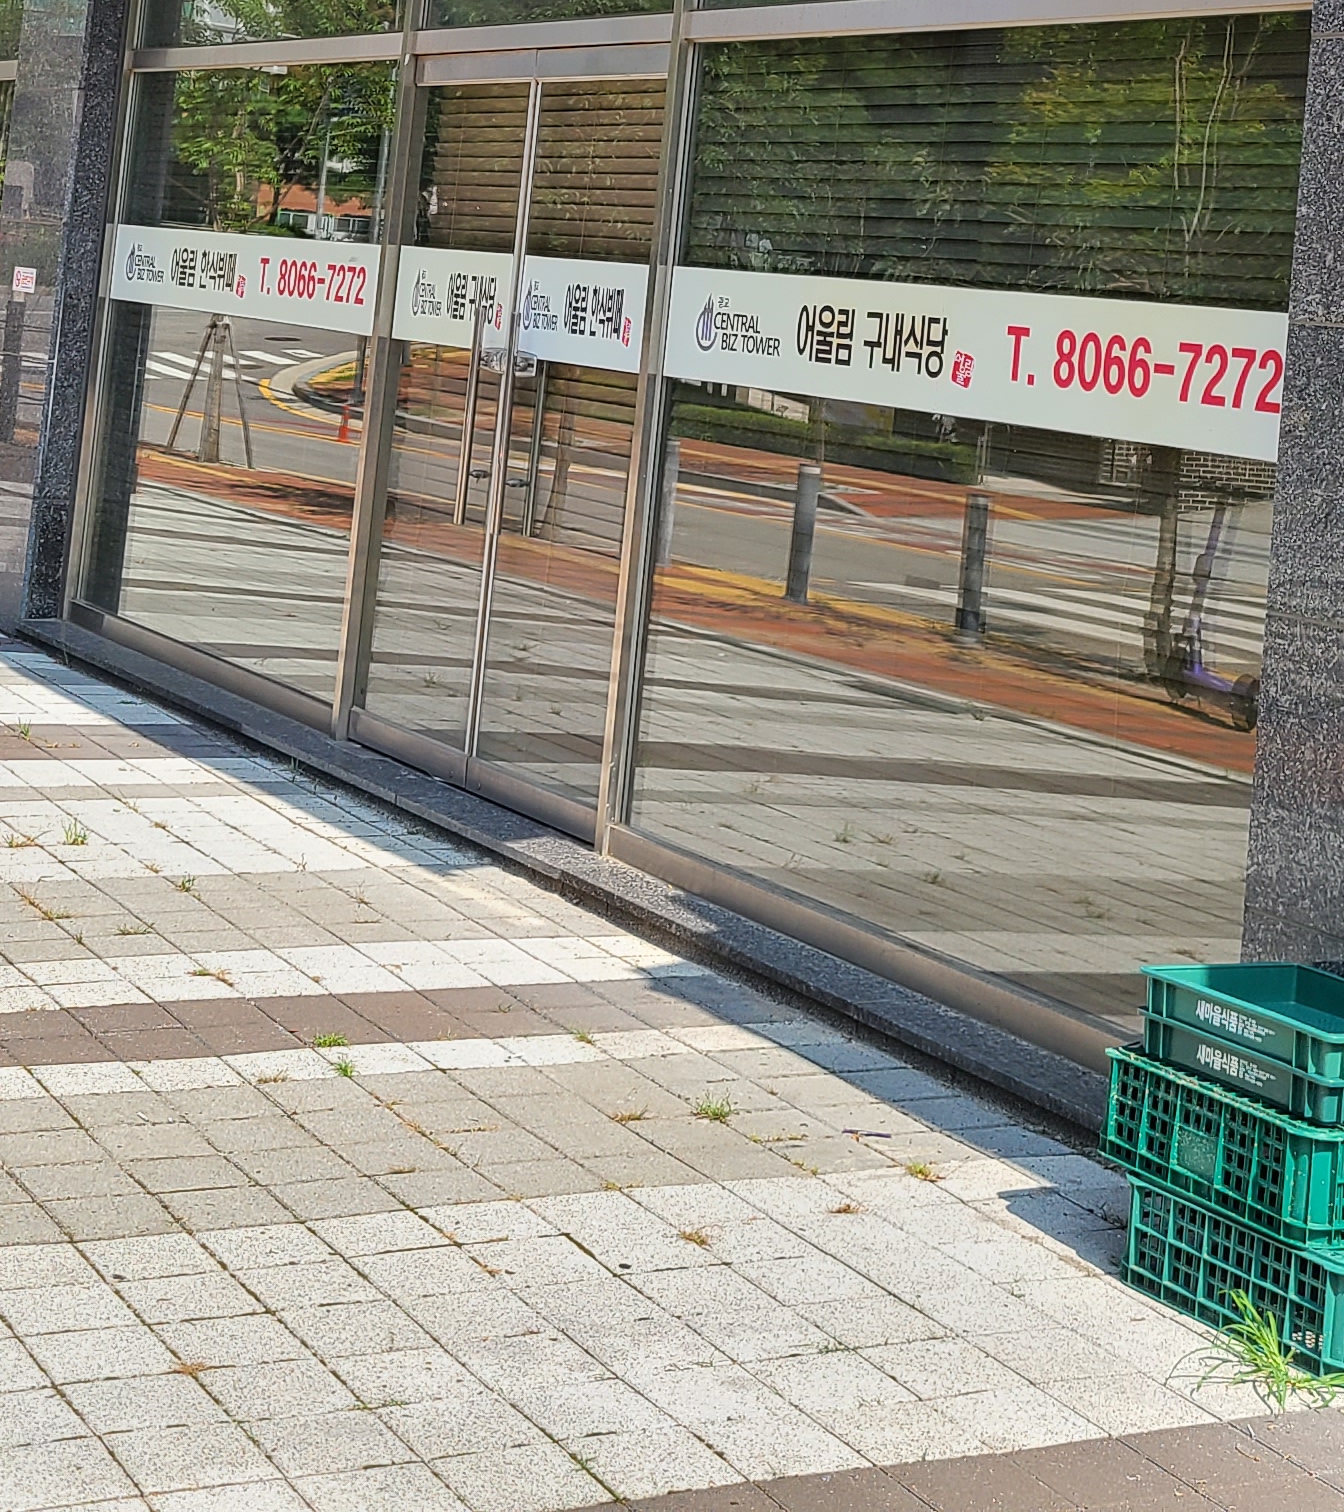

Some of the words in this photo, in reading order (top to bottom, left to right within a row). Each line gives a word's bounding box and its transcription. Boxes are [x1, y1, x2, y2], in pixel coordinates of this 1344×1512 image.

[171, 248, 197, 288] 어울림
[198, 249, 238, 292] 한식뷔페
[260, 257, 270, 295] T.
[277, 259, 367, 305] 8066-7272
[447, 273, 468, 321] 어울림
[564, 283, 589, 336] 어울림
[589, 285, 624, 340] 한식뷔페
[714, 312, 761, 335] CENTRAL
[721, 332, 737, 351] BIZ
[740, 335, 781, 357] TOWER
[797, 304, 856, 367] 어울림
[863, 311, 949, 379] 구내식당
[1007, 325, 1035, 386] T.
[1053, 329, 1284, 414] 8066-7272
